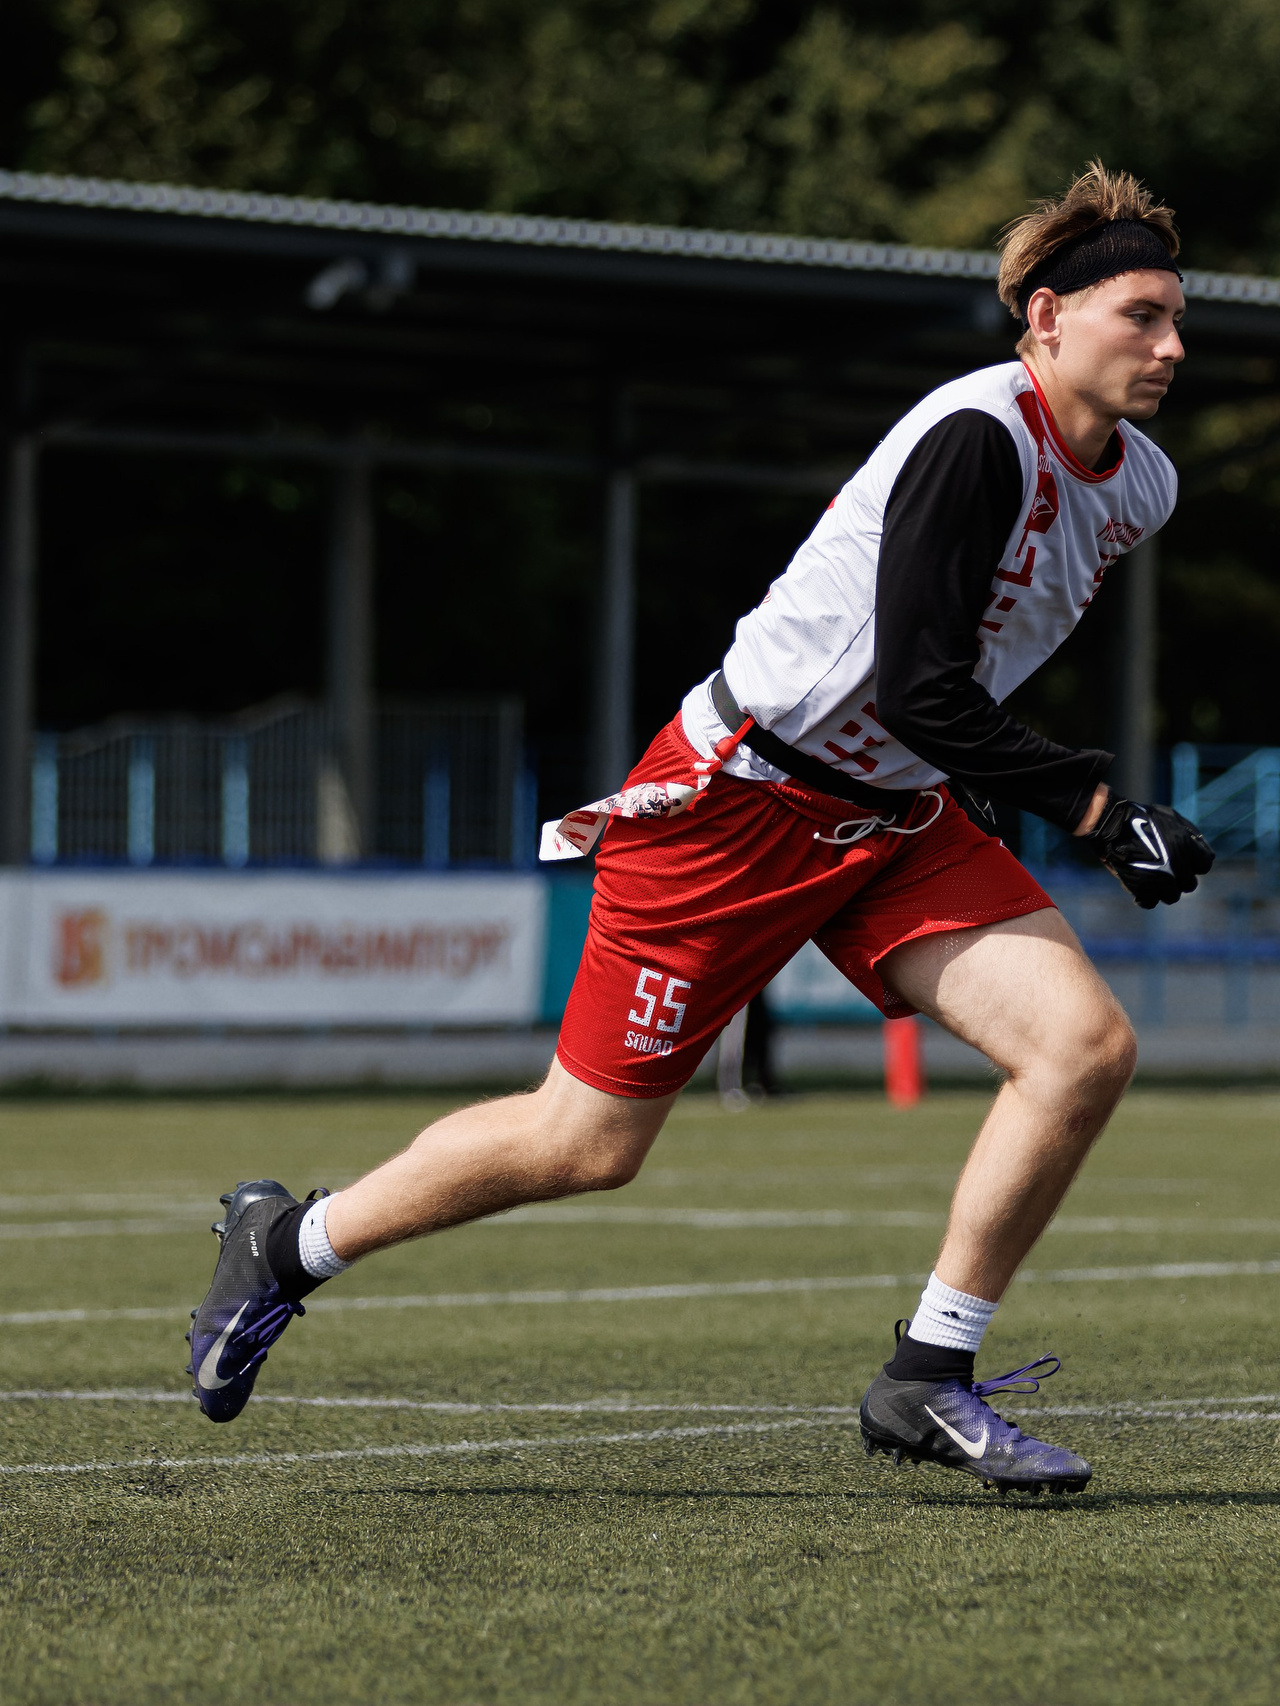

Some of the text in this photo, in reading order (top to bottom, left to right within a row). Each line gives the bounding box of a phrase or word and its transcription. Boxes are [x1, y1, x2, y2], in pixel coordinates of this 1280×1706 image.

[627, 966, 692, 1033] 55
[624, 1030, 674, 1056] SQUAD
[249, 1230, 260, 1257] VAPOR
